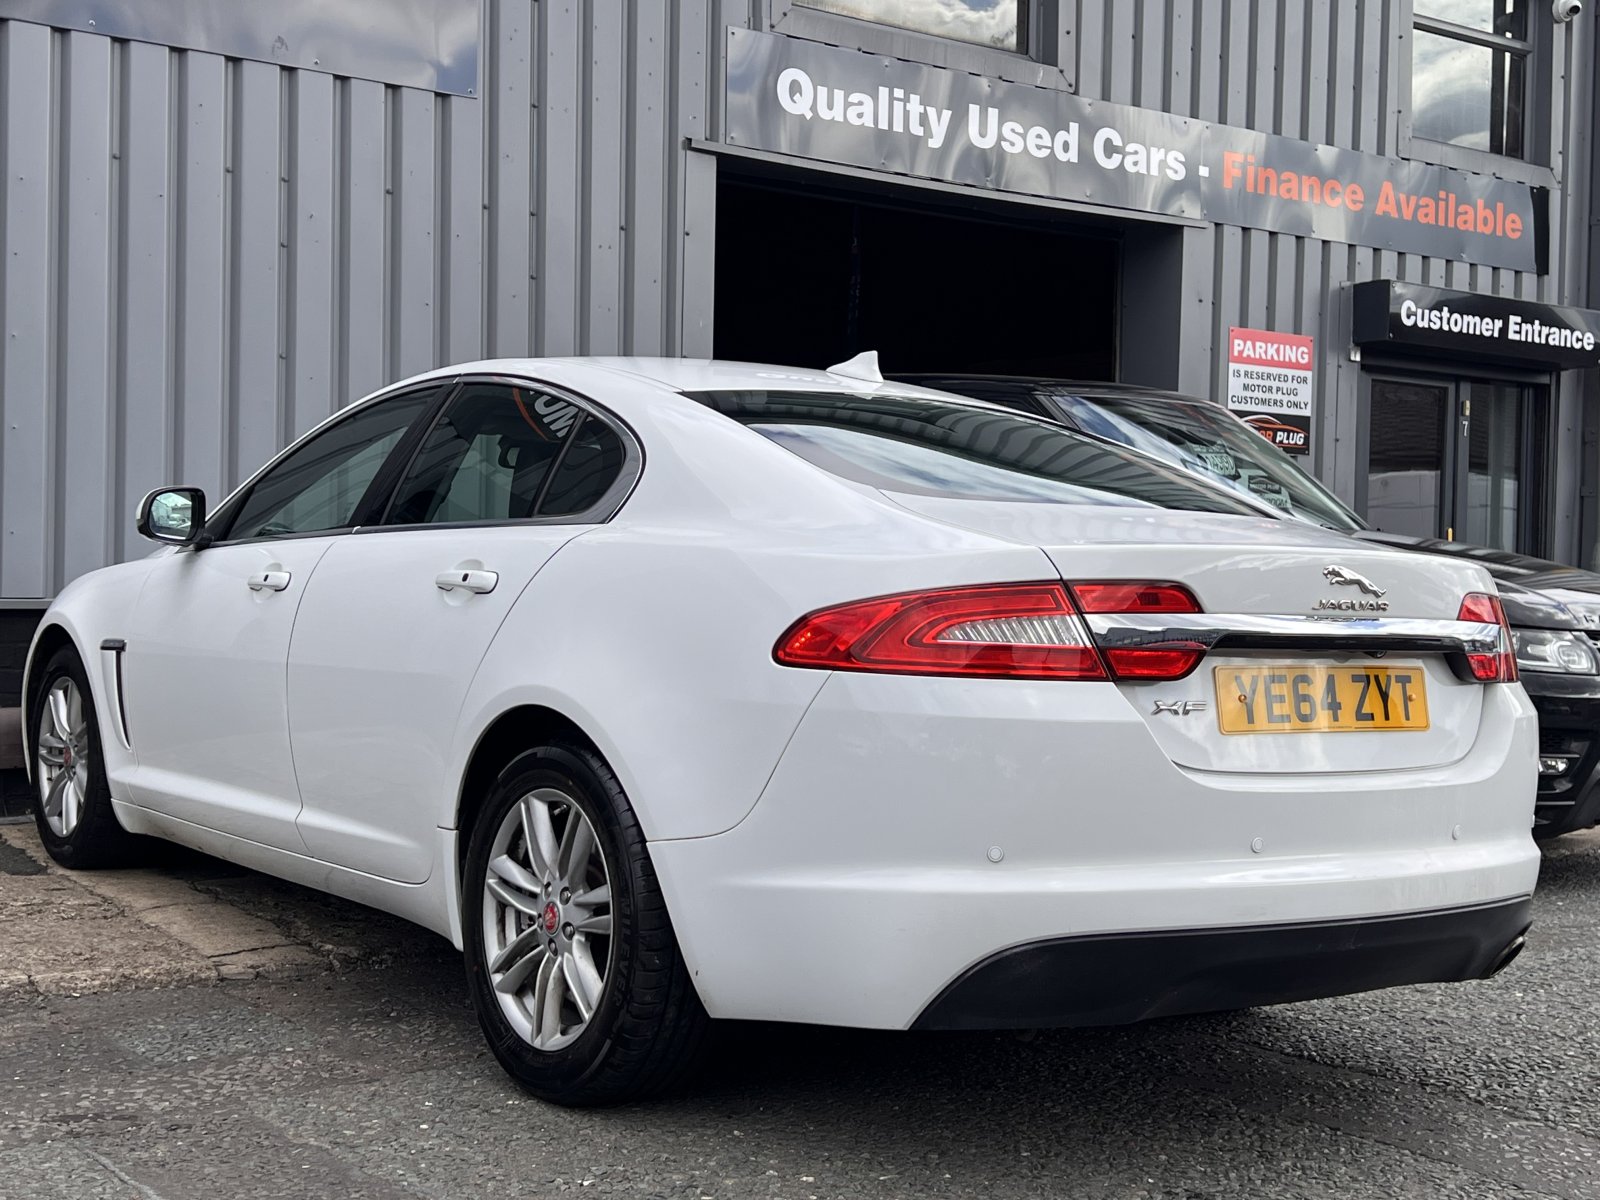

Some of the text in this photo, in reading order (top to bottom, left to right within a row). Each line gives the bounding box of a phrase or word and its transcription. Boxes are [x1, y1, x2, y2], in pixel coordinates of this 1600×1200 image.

[776, 67, 953, 149] Quality
[966, 103, 1080, 164] Used
[1093, 126, 1187, 181] Cars
[1223, 151, 1364, 212] Finance
[1375, 181, 1523, 240] Available
[1400, 299, 1596, 351] Customer Entrance
[1233, 338, 1309, 364] PARKING
[1232, 369, 1308, 384] IS RESERVED FOR
[1242, 383, 1298, 396] MOTOR PLUG
[1231, 394, 1308, 410] CUSTOMERS ONLY
[1462, 420, 1469, 437] 7
[1275, 431, 1305, 445] PLUG
[1311, 599, 1389, 612] JAGUAR
[1234, 673, 1412, 725] YE64 ZYT
[1150, 700, 1208, 716] XF
